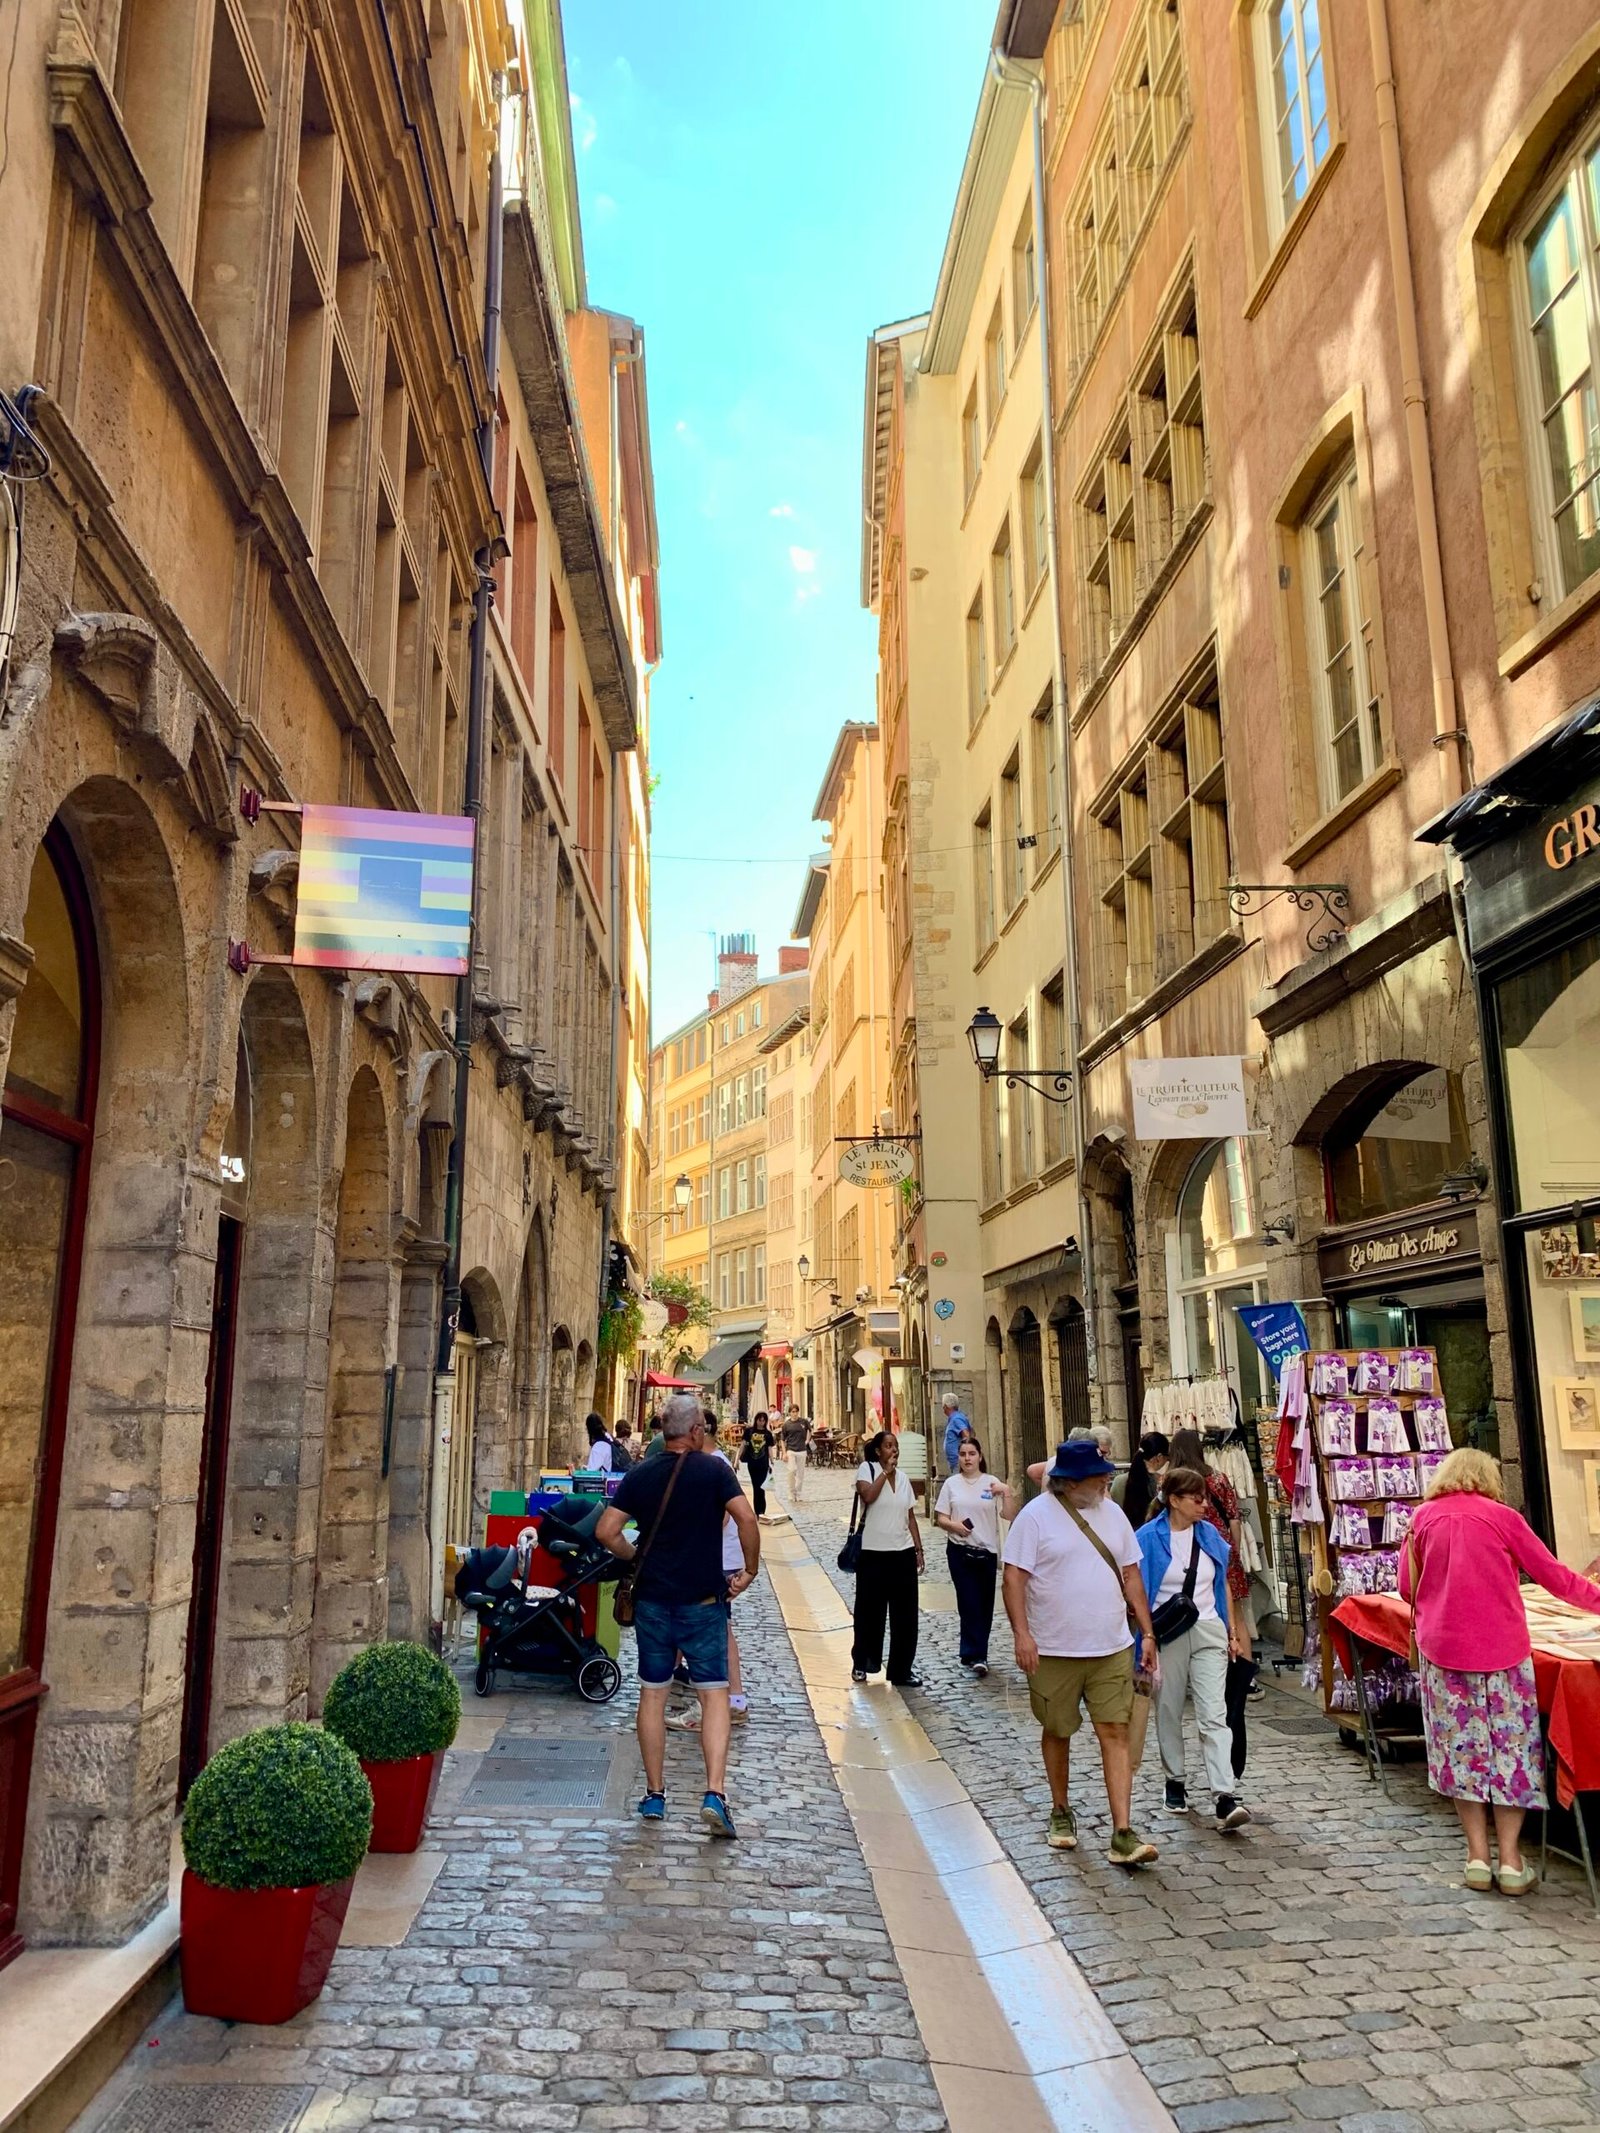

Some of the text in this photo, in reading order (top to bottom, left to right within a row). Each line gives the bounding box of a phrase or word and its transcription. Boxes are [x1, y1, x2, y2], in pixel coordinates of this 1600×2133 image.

[1136, 1082, 1241, 1097] LE TRUFFICULTEUR
[845, 1143, 907, 1162] LE PALAIS
[870, 1159, 899, 1170] JEAN
[849, 1170, 905, 1186] RESTAURANT
[1349, 1226, 1458, 1272] La Main des Anges
[1260, 1322, 1297, 1344] Store your
[1265, 1332, 1299, 1352] bags here
